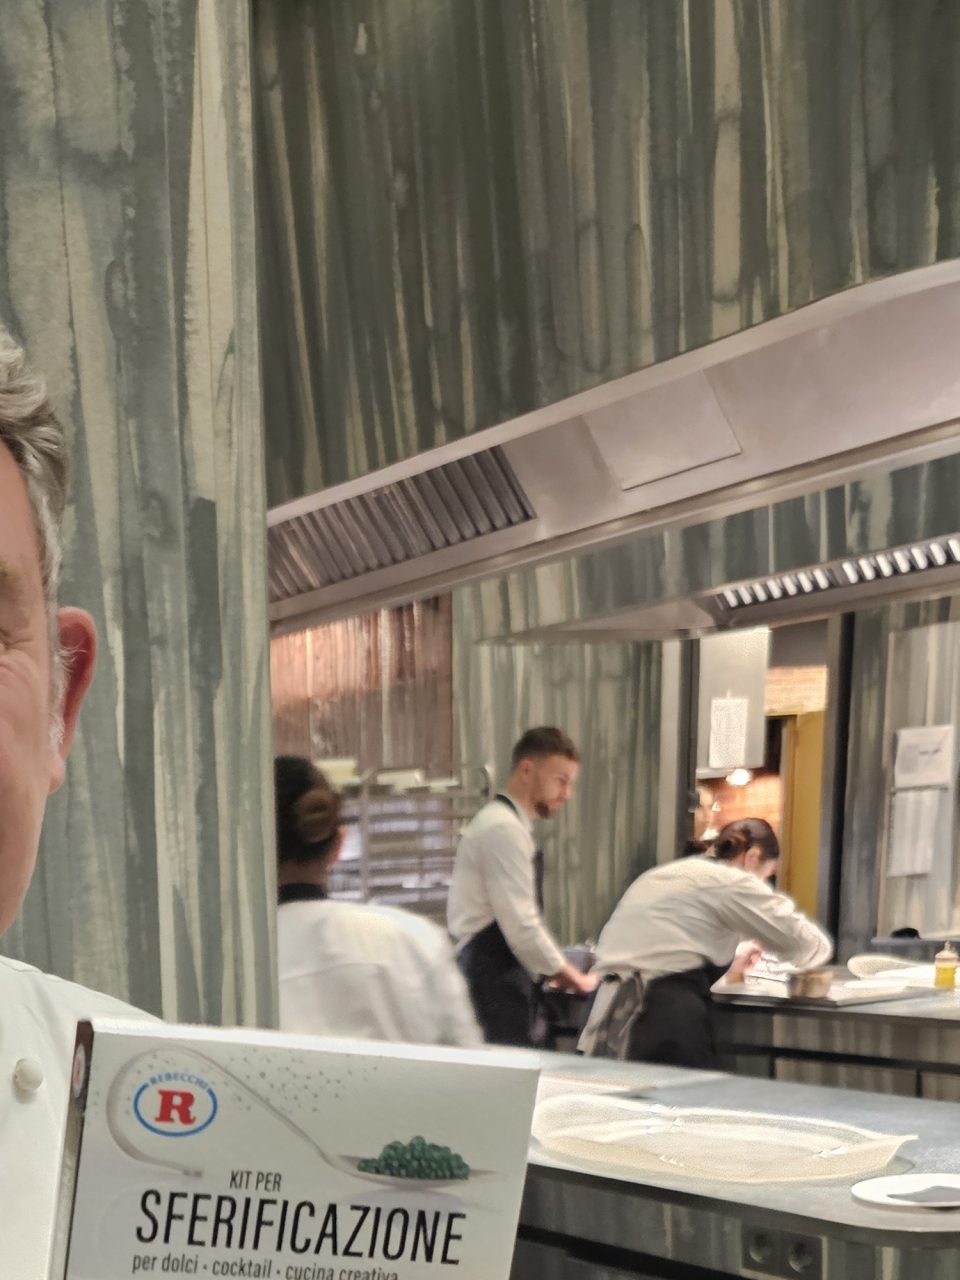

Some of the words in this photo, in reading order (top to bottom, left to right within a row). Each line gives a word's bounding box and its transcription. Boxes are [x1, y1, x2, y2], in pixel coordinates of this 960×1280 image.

[154, 1089, 196, 1125] R
[229, 1170, 252, 1190] KIT
[255, 1171, 282, 1193] PER
[135, 1189, 467, 1266] SFERIFICAZIONE
[132, 1254, 157, 1275] per
[161, 1252, 199, 1274] dolci
[212, 1257, 273, 1279] cocktail
